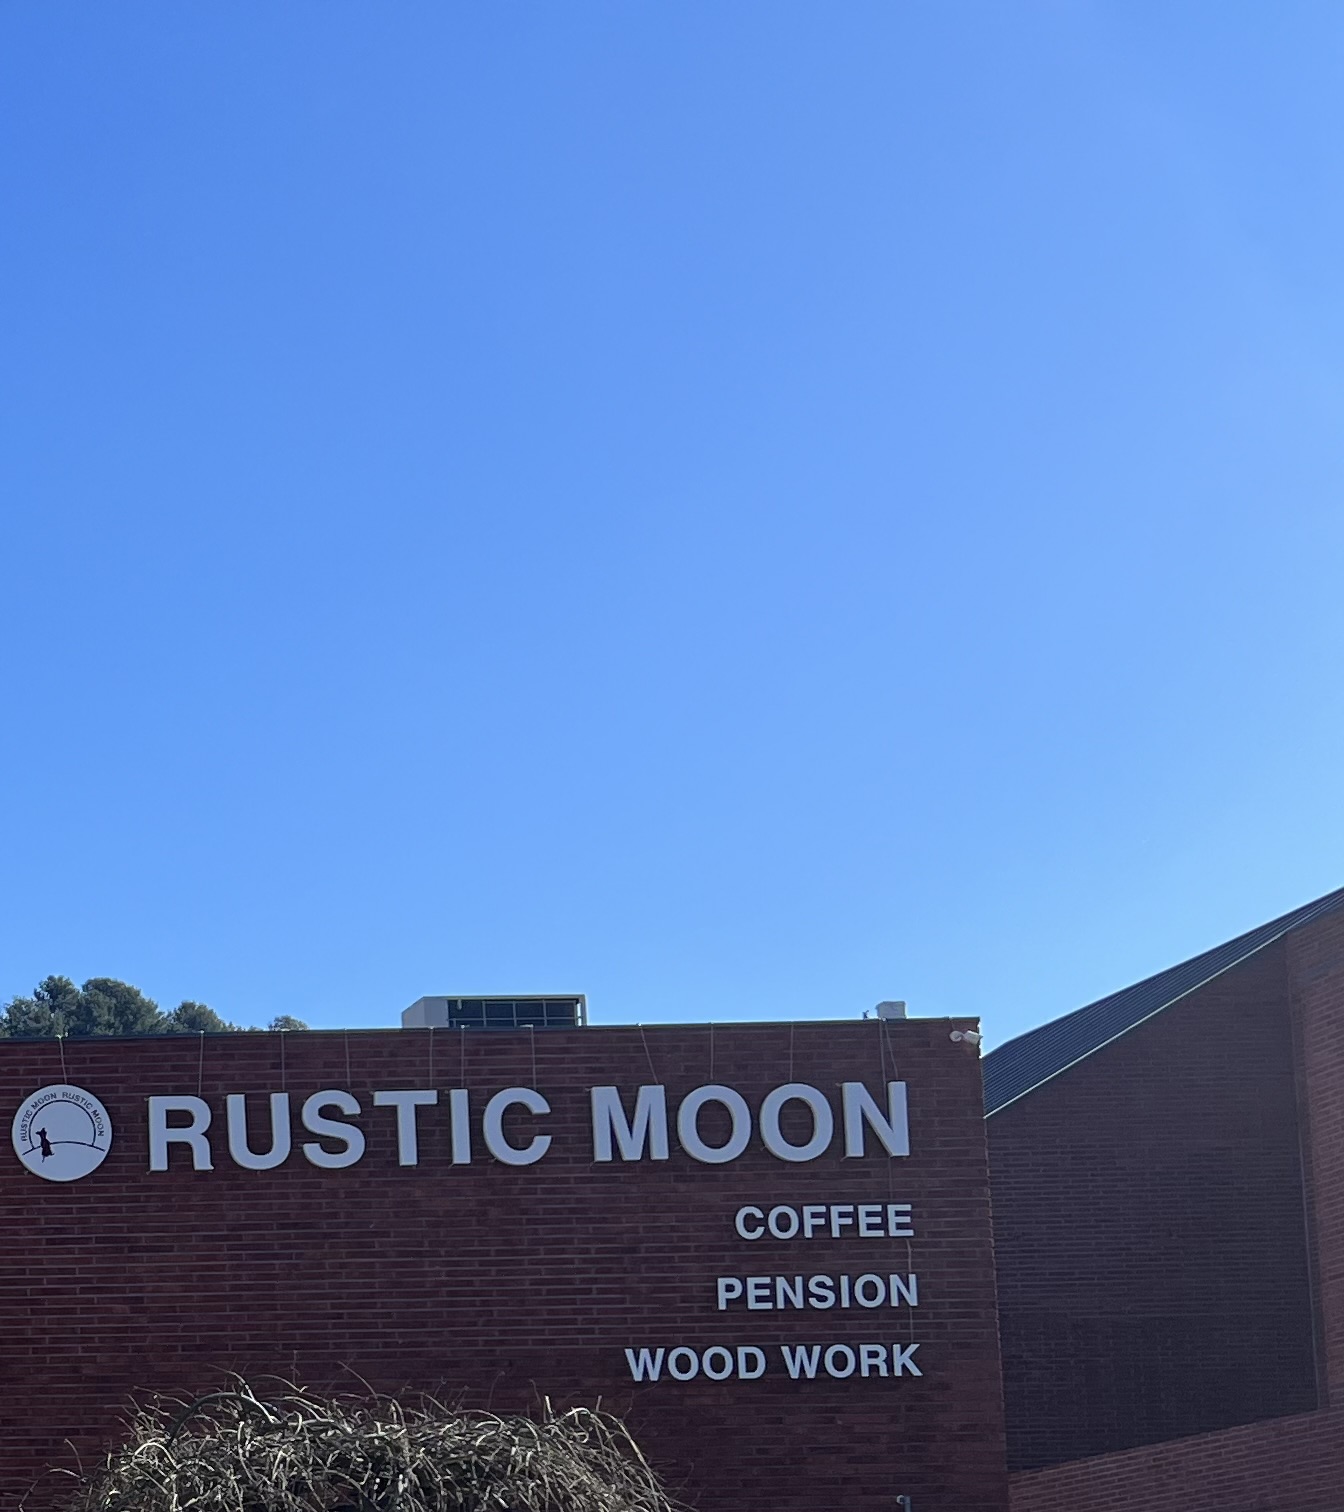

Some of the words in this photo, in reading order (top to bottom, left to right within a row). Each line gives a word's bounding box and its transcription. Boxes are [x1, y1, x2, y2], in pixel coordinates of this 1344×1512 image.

[20, 1109, 33, 1141] RUSTIC
[31, 1092, 57, 1110] MOON
[62, 1091, 93, 1110] RUSTIC
[90, 1109, 105, 1137] MOON
[148, 1084, 552, 1171] RUSTIC
[591, 1081, 910, 1164] MOON
[735, 1204, 914, 1240] COFFEE
[717, 1273, 918, 1311] PENSION
[624, 1346, 766, 1382] WOOD
[780, 1343, 923, 1380] WORK
